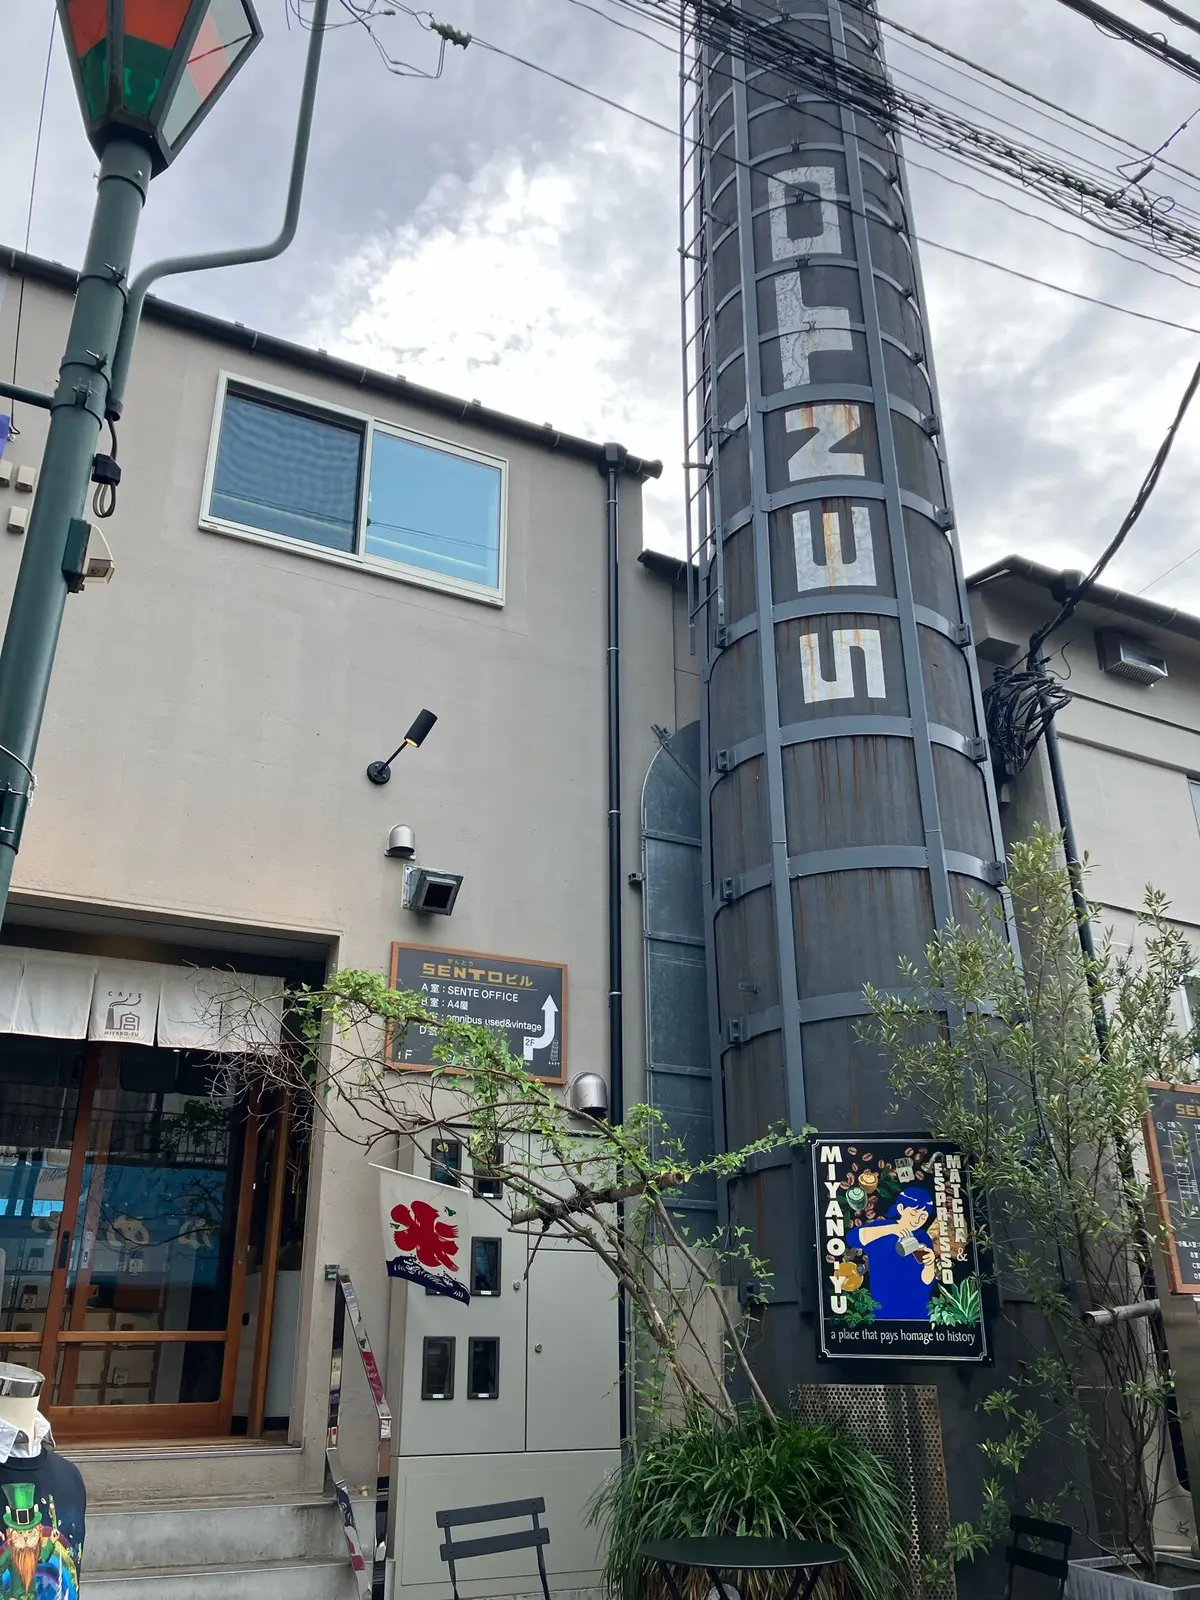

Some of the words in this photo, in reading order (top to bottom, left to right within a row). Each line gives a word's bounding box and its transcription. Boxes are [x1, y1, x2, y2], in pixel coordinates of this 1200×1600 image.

[767, 166, 887, 704] SENTO
[107, 990, 142, 999] CAFE
[447, 985, 480, 998] SENTE
[481, 989, 519, 1002] OFFICE
[525, 1038, 535, 1047] 2F
[820, 1145, 848, 1315] MIYANO-YU
[933, 1162, 954, 1285] ESPRESSO
[945, 1154, 967, 1243] MATCHA
[956, 1247, 968, 1262] &
[830, 1330, 836, 1340] a
[838, 1328, 860, 1343] place
[861, 1328, 878, 1341] that
[880, 1331, 899, 1345] pays
[900, 1329, 934, 1345] homage
[935, 1331, 945, 1342] to
[947, 1329, 976, 1346] history
